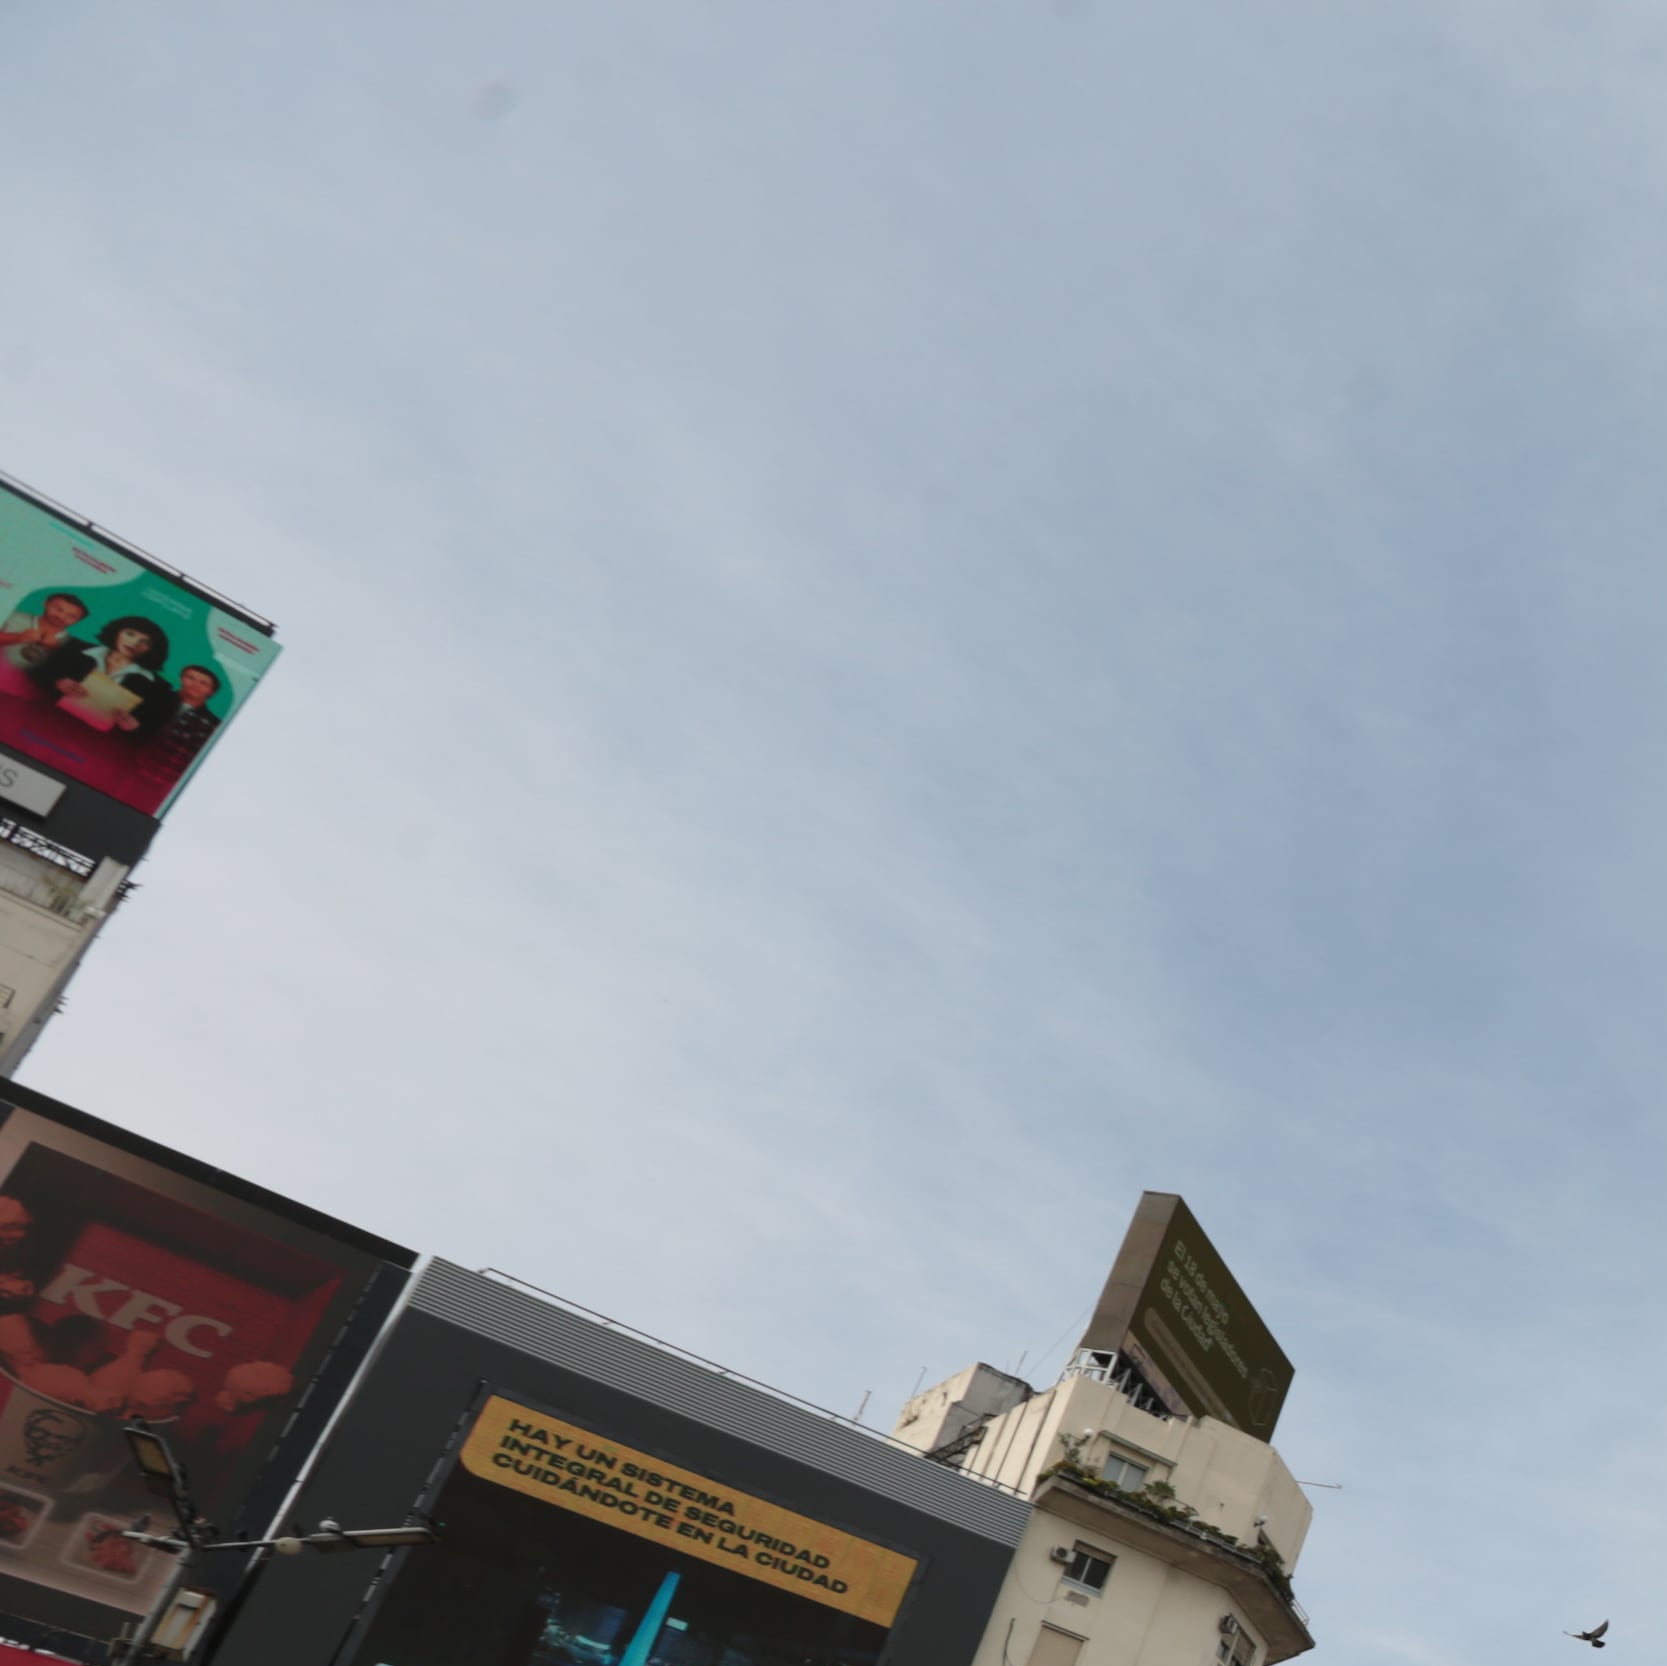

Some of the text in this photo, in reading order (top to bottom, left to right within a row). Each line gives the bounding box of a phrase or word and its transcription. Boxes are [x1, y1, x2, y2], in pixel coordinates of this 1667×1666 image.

[39, 1263, 234, 1358] KFC
[492, 1453, 848, 1594] CUIDÁNDOTE EN LA CIUDAD
[499, 1435, 831, 1569] INTEGRAL DE SEGURIDAD
[509, 1418, 735, 1516] HAY UN SISTEMA
